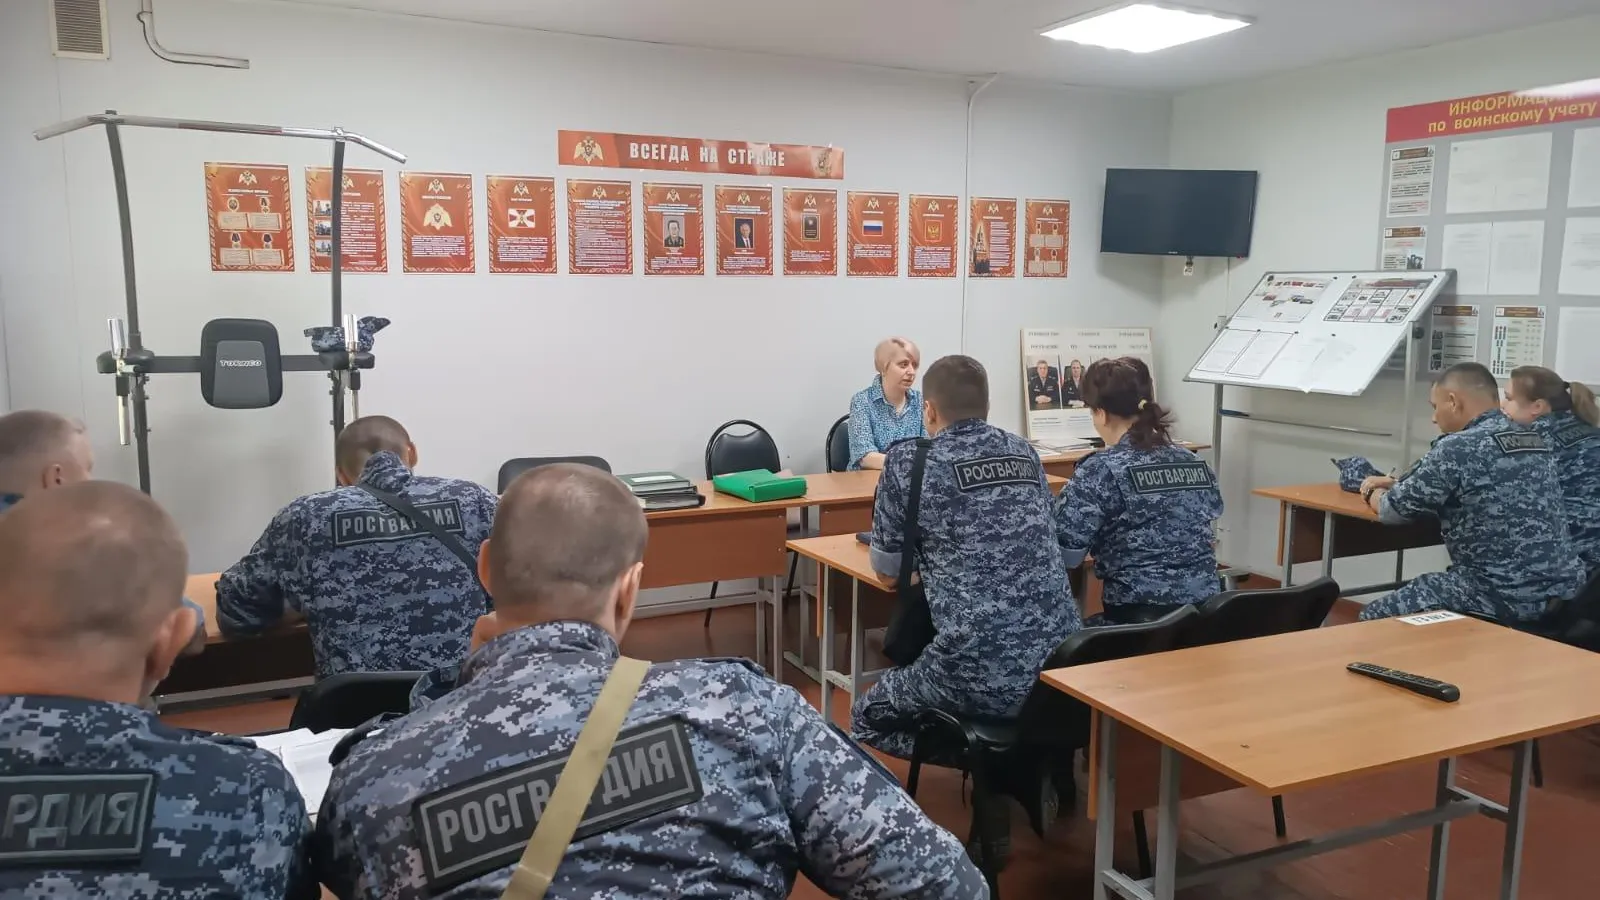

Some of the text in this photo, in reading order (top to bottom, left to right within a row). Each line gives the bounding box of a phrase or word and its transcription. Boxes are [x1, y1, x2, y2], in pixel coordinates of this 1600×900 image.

[1428, 101, 1597, 133] по воинскому учету
[1449, 94, 1574, 117] ИНФОРМАЦ
[629, 142, 785, 166] ВСЕГДА НА СТРАЖЕ
[963, 460, 1034, 482] РОСГВАРДИЯ
[1136, 467, 1206, 487] РОСГВАРДИЯ
[342, 507, 456, 536] РОСГВАИЯ
[437, 740, 676, 853] РОСГВДИЯ
